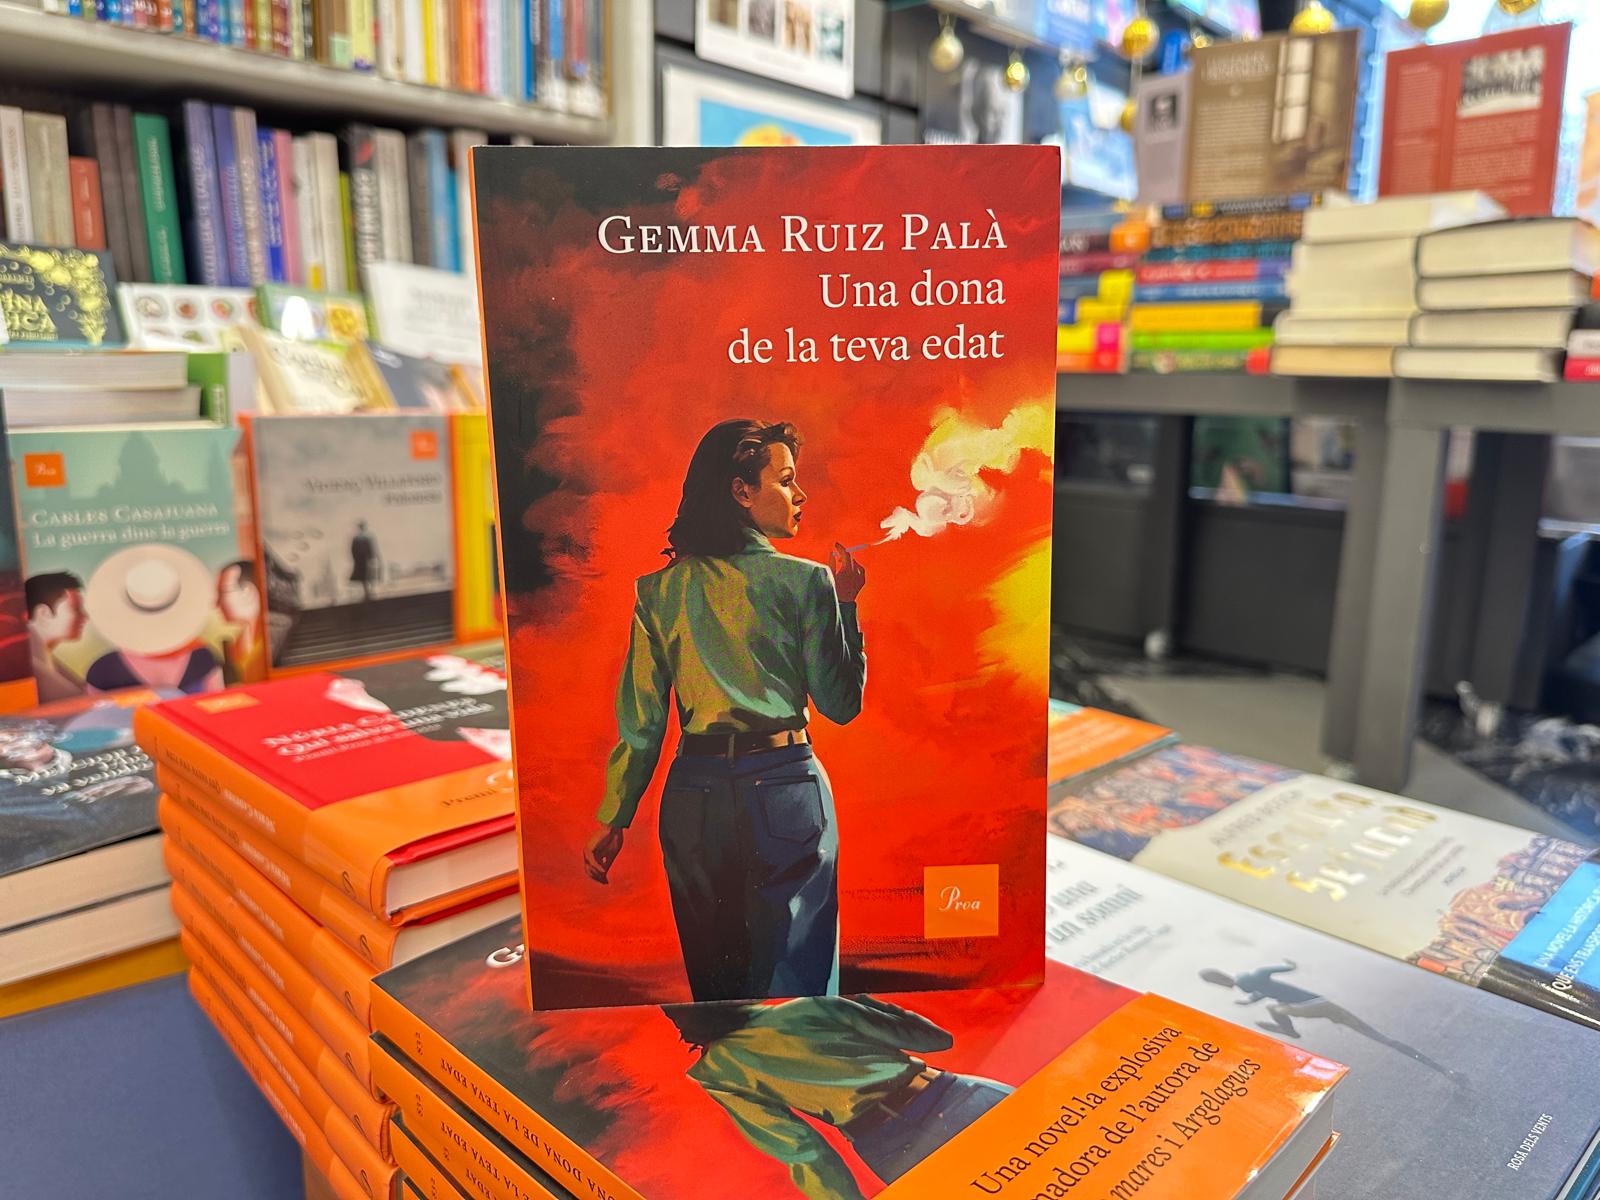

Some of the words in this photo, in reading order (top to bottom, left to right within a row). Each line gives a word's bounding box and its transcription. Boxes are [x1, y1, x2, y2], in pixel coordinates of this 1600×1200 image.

[597, 214, 766, 255] GEMMA
[781, 215, 884, 253] RUIZ
[901, 208, 1008, 251] PALÀ
[818, 273, 899, 308] Una
[910, 269, 1006, 307] dona
[727, 328, 774, 364] de
[787, 328, 819, 363] la
[830, 333, 909, 363] teva
[921, 324, 1005, 361] edat
[31, 508, 109, 527] CARLES
[114, 502, 219, 523] CASAJUANA
[61, 529, 117, 549] guerra
[938, 886, 981, 912] Proa
[1552, 970, 1576, 990] QUE
[440, 1057, 468, 1089] EDAT
[470, 1083, 501, 1116] TEVA
[1100, 1119, 1135, 1145] de
[1187, 1040, 1220, 1063] de
[503, 1110, 520, 1132] LA
[969, 1158, 1031, 1195] Una
[1100, 1025, 1183, 1093] explosiva
[440, 1120, 468, 1153] EDAT
[522, 1125, 540, 1149] DE
[1110, 1145, 1172, 1200] mares
[1157, 1134, 1183, 1150] i
[1172, 1057, 1261, 1141] Argelagues
[1506, 1150, 1529, 1171] ROSA
[1519, 1133, 1540, 1152] DELS
[1530, 1112, 1554, 1135] VENTS
[470, 1147, 501, 1182] TEVA
[543, 1142, 582, 1183] DONA
